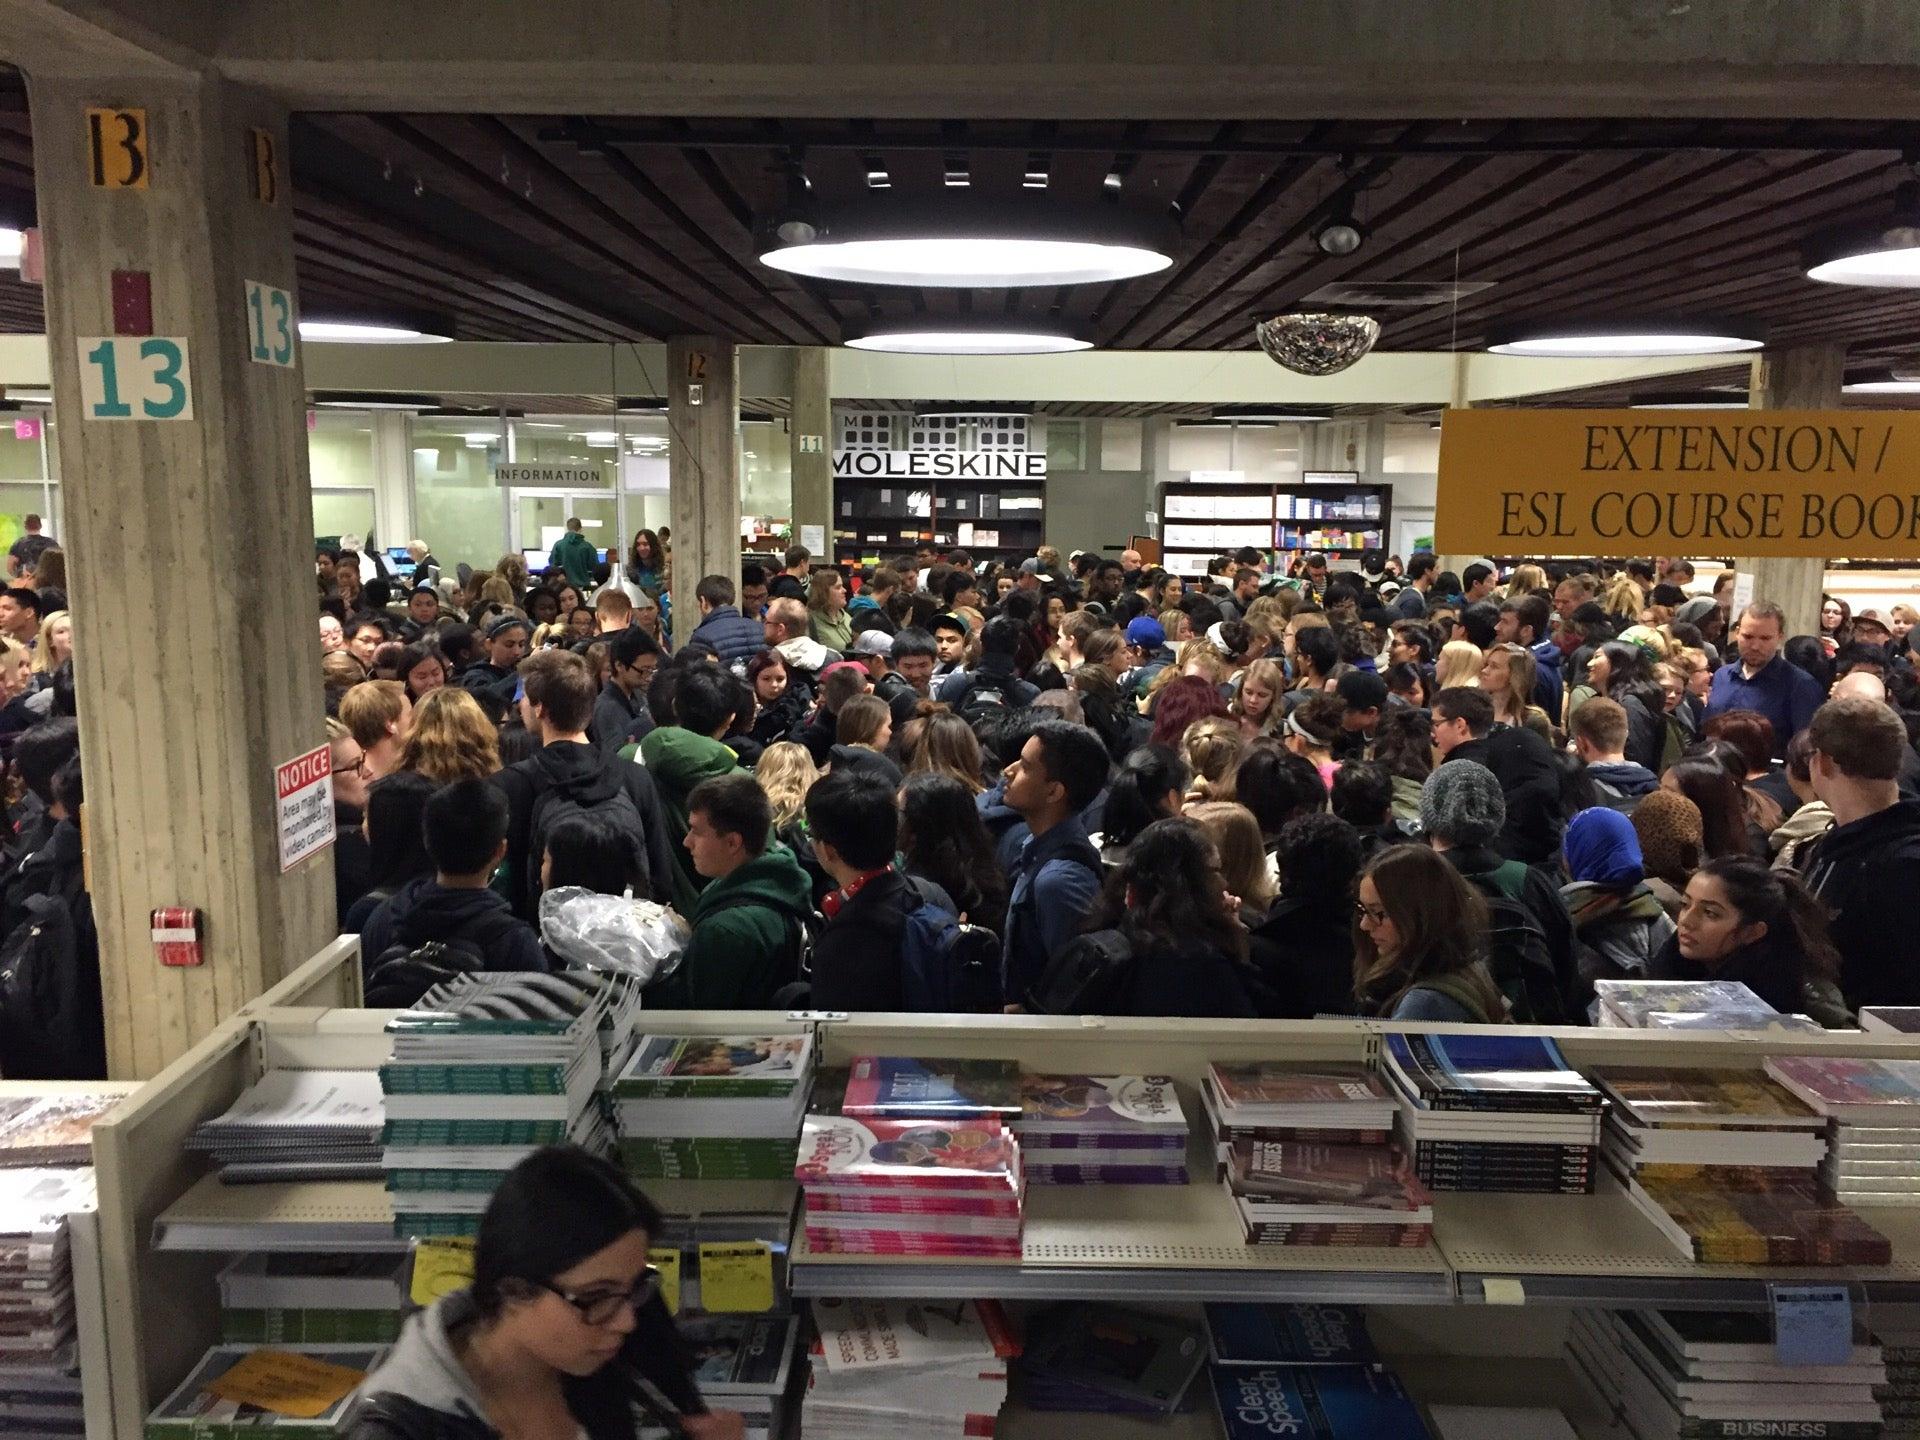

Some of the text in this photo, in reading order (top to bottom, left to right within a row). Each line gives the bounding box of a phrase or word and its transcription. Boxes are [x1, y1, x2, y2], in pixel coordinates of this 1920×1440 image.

[90, 113, 145, 186] 13
[250, 286, 293, 366] 13
[88, 338, 187, 418] 13
[801, 436, 823, 452] 11
[832, 452, 1046, 477] MOLESKINE
[1581, 425, 1893, 473] EXTENSION /
[495, 468, 601, 482] INFORMATION
[1498, 491, 1577, 539] ESL
[1591, 491, 1785, 539] COURSE
[280, 751, 327, 794] NOTICE
[283, 802, 300, 819] Area
[284, 823, 333, 859] video camera
[1235, 1377, 1270, 1425] Clear
[1722, 1421, 1827, 1438] BUSINESS
